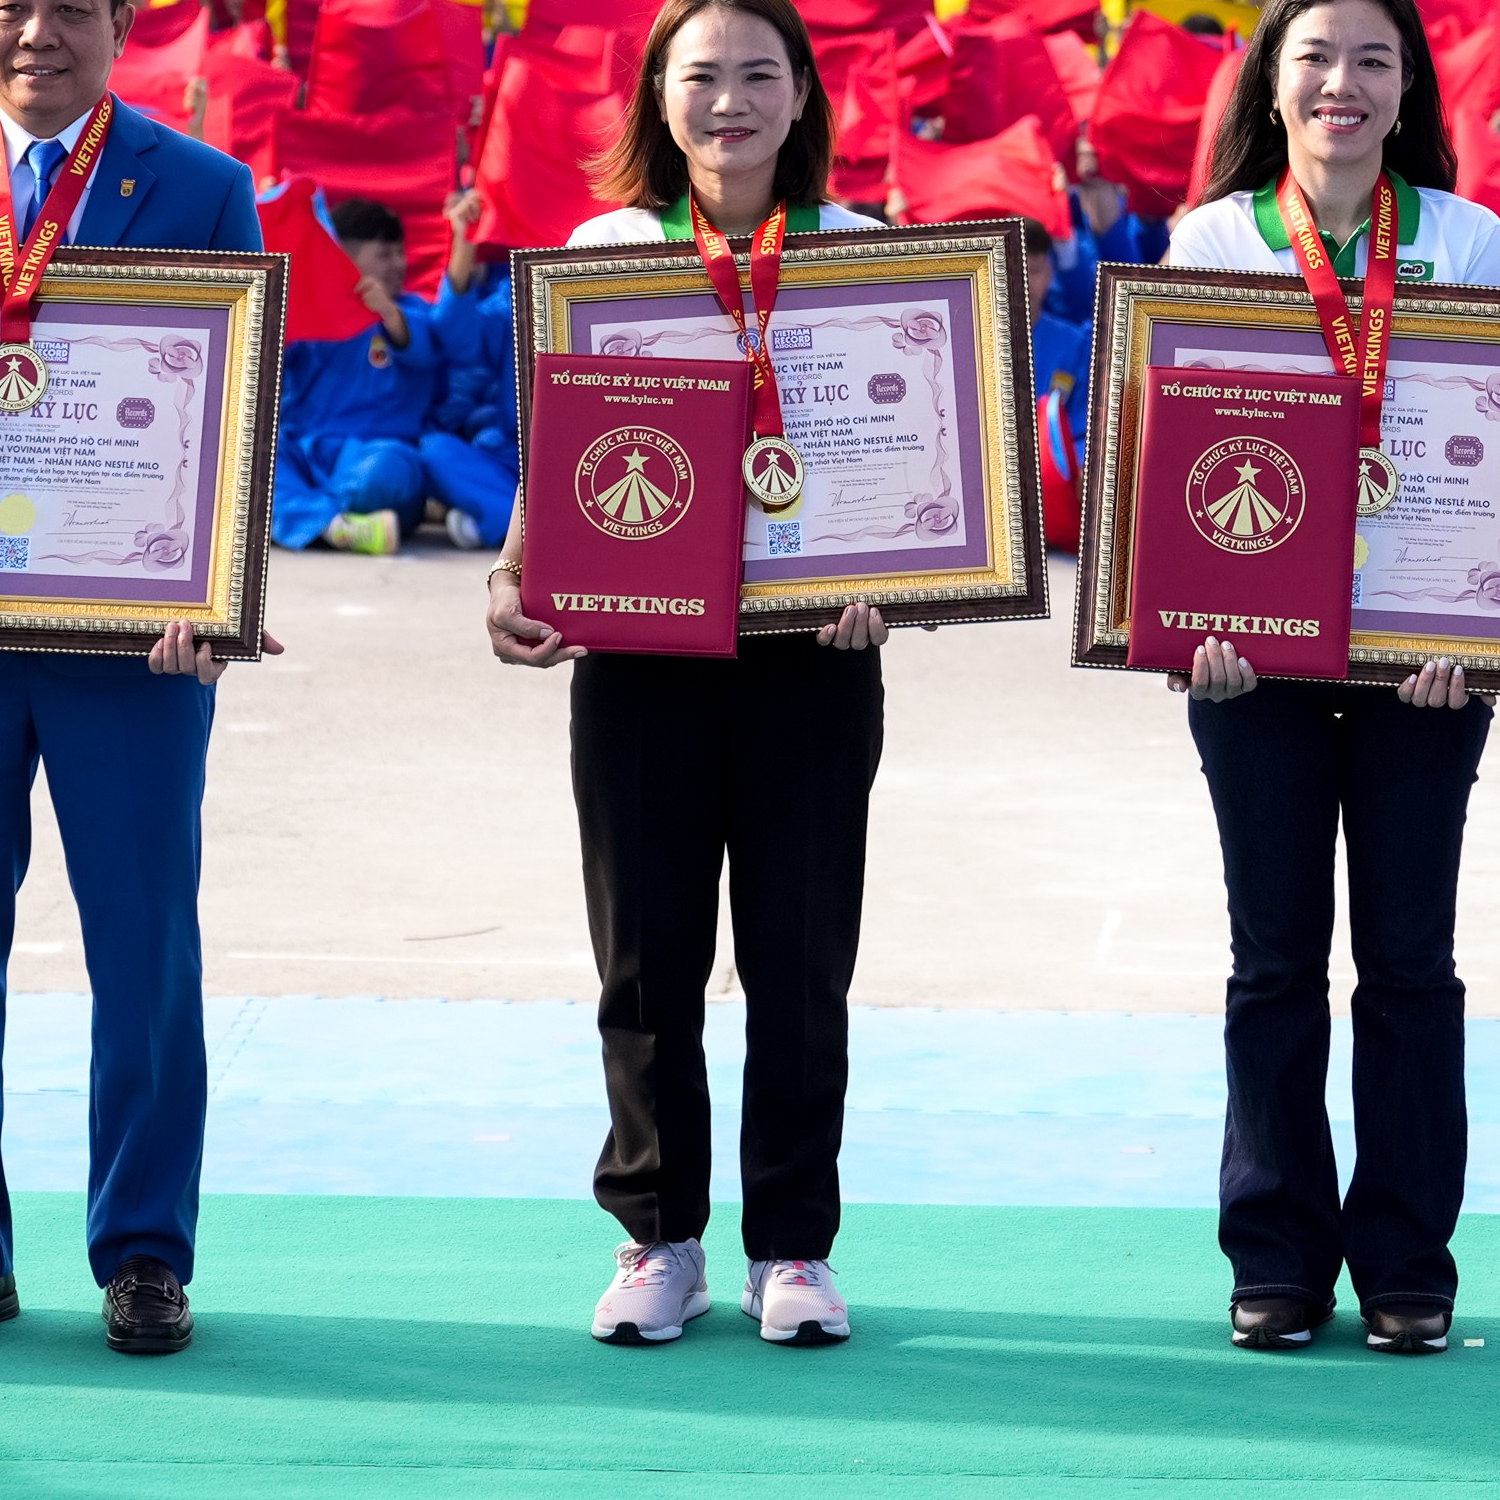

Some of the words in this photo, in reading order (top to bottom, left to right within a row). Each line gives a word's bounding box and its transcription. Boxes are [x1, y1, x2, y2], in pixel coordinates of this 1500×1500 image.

[69, 101, 112, 176] VIETKINGS
[1285, 193, 1324, 270] VIETKINGS
[1375, 186, 1392, 260] VIETKINGS
[11, 219, 59, 297] VIETKINGS
[1399, 265, 1423, 275] MILO
[774, 328, 811, 337] VIETNAM
[774, 335, 811, 344] RECORD
[1362, 308, 1385, 397] VIETKINGS
[792, 363, 813, 373] VIỆT
[817, 361, 844, 370] NAM
[70, 379, 96, 388] NAM
[551, 370, 571, 385] TỔ
[572, 372, 611, 387] CHỨC
[613, 373, 632, 387] KỶ
[633, 376, 661, 390] LỤC
[663, 376, 696, 392] VIỆT
[697, 379, 731, 391] NAM
[604, 394, 674, 406] www.kyluc.vn
[782, 382, 807, 405] KỶ
[814, 384, 849, 406] LỤC
[1161, 381, 1181, 397] TỔ
[1182, 383, 1221, 399] CHỨC
[1223, 384, 1243, 399] KỶ
[1244, 389, 1272, 403] LỤC
[1274, 388, 1307, 406] VIỆT
[1309, 392, 1342, 406] NAM
[62, 403, 98, 424] LỤC
[870, 415, 895, 423] MINH
[1214, 406, 1285, 420] www.kyluc.vn
[4, 434, 22, 443] TẠO
[25, 434, 56, 444] THÀNH
[58, 435, 78, 445] PHỐ
[115, 439, 139, 447] MINH
[863, 435, 893, 445] NESTLÉ
[896, 434, 918, 442] MILO
[7, 445, 50, 454] VOVINAM
[54, 446, 72, 457] VIỆT
[75, 448, 96, 456] NAM
[589, 437, 615, 462] CHỨC
[633, 432, 655, 444] LỤC
[655, 436, 678, 456] VIỆT
[672, 454, 689, 481] NAM
[1390, 439, 1426, 461] LỤC
[13, 456, 35, 465] NAM
[105, 459, 134, 469] NESTLÉ
[137, 462, 160, 471] MILO
[1201, 446, 1228, 471] CHỨC
[1245, 442, 1268, 454] LỤC
[1268, 448, 1291, 469] VIỆT
[1285, 468, 1300, 496] NAM
[1444, 477, 1469, 485] MINH
[760, 490, 792, 501] VIETKINGS
[1435, 496, 1465, 506] NESTLÉ
[1467, 500, 1490, 508] MILO
[602, 518, 664, 537] VIETKINGS
[1211, 529, 1274, 551] VIETKINGS
[551, 593, 706, 616] VIETKINGS
[1158, 609, 1320, 638] VIETKINGS
